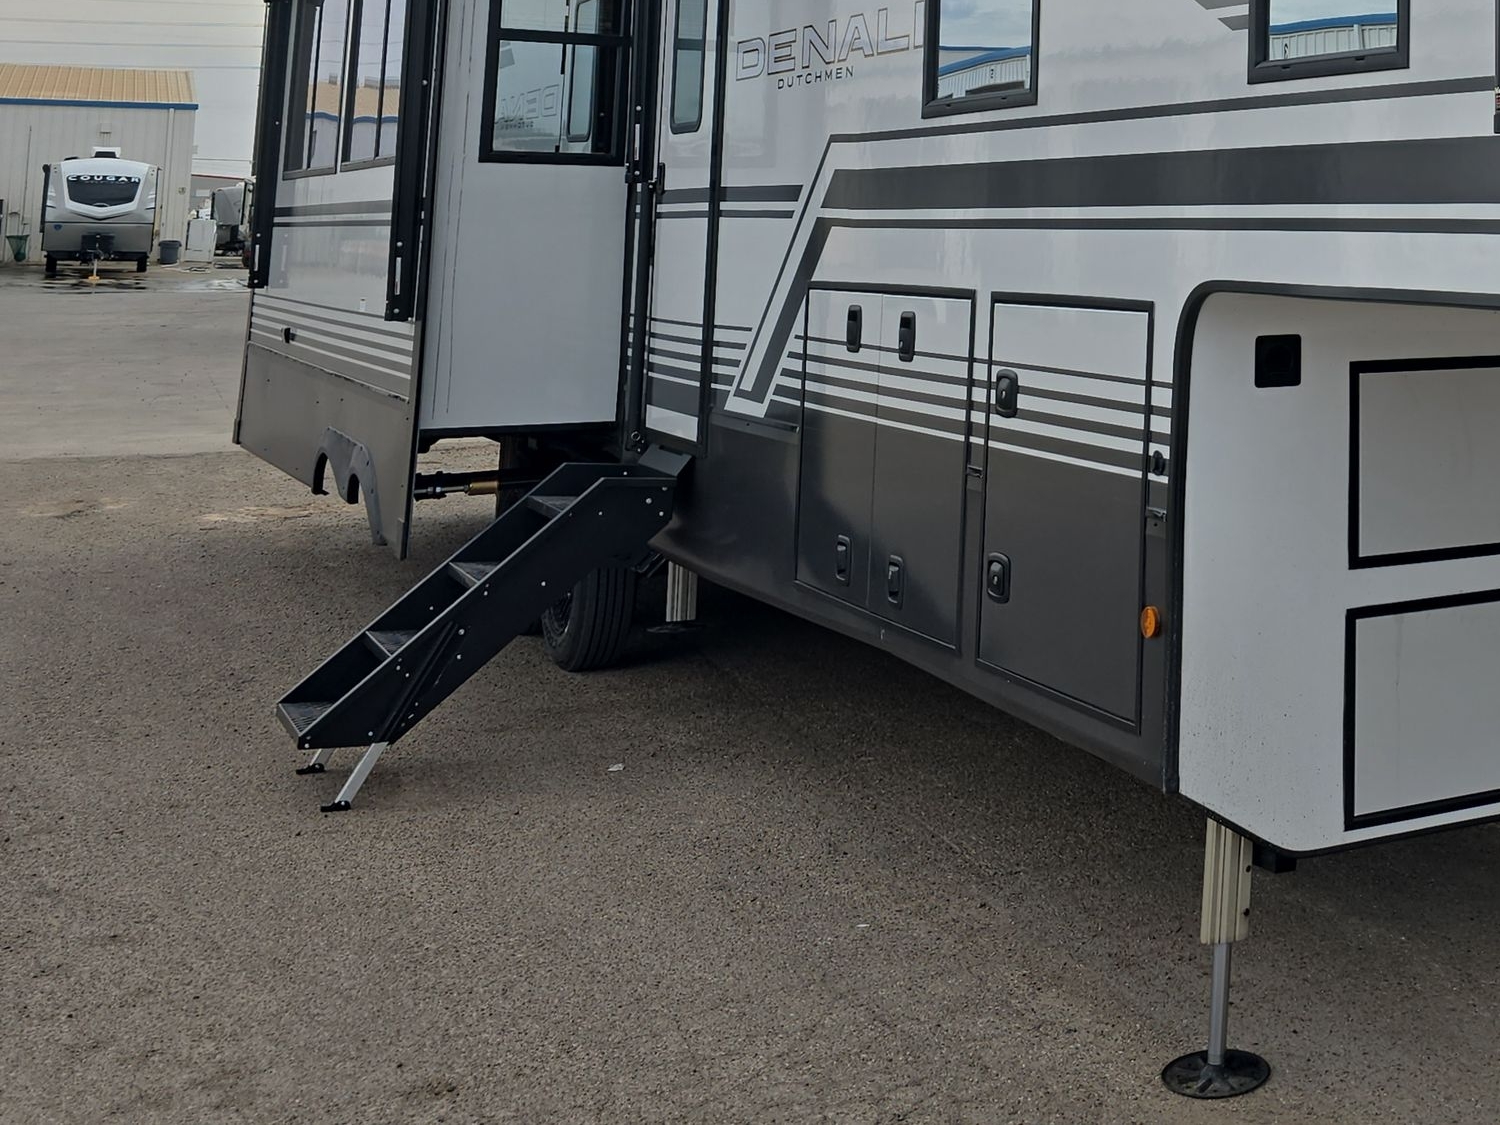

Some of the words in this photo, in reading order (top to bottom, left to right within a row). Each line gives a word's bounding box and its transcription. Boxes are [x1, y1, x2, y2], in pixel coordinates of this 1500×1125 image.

[736, 0, 925, 81] DENALI
[777, 65, 854, 90] DUTCHMEN
[68, 175, 139, 183] COUGAR
